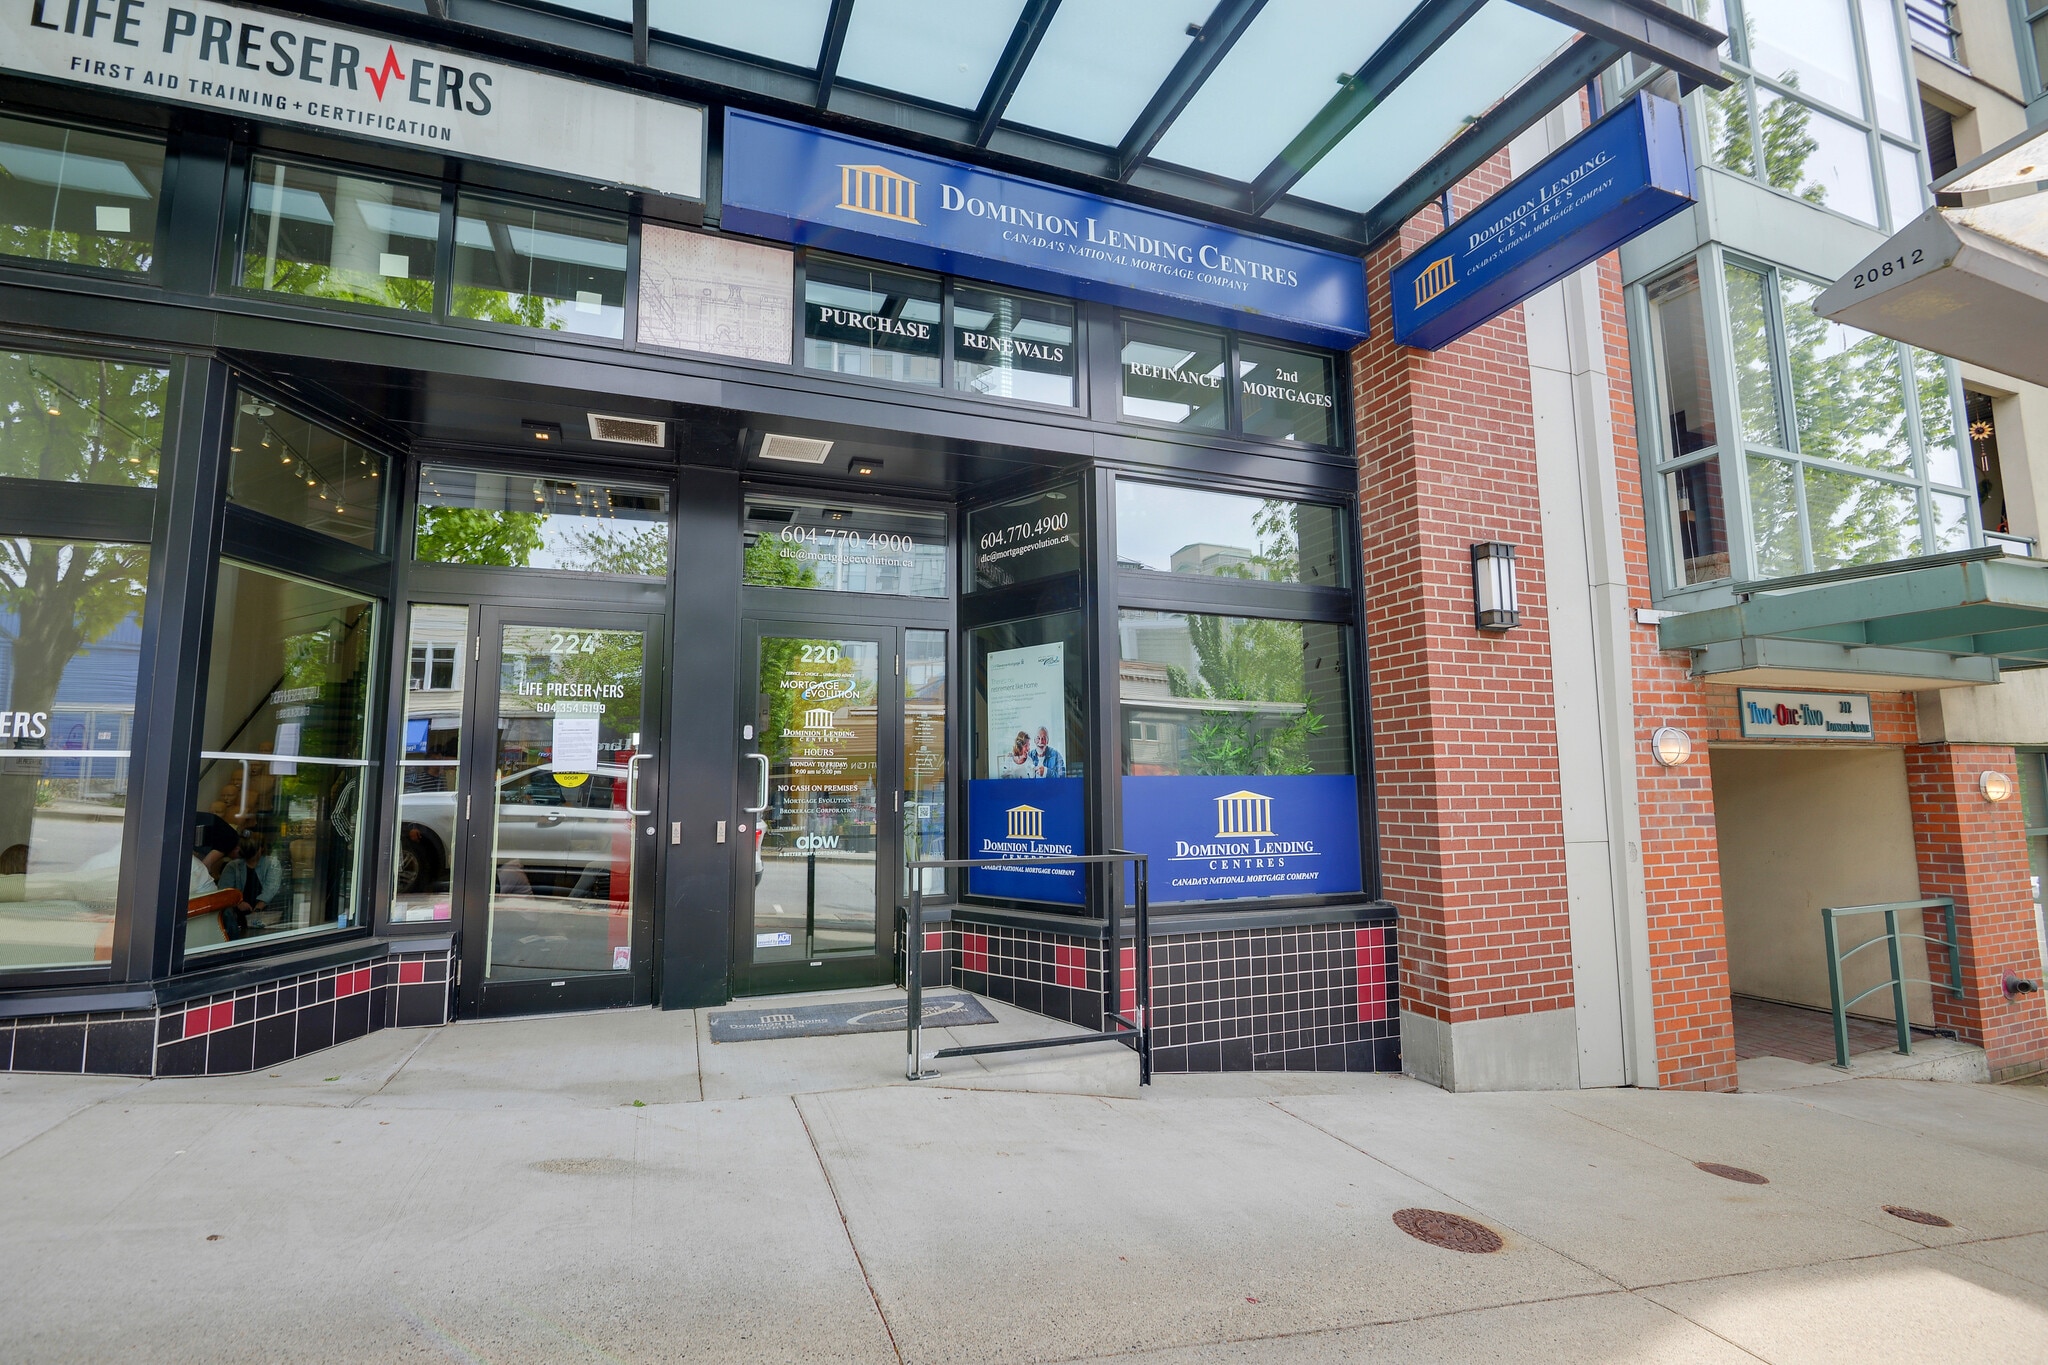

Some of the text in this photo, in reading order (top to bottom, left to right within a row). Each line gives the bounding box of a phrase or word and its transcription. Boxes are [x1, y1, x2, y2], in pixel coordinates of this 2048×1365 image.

[31, 0, 145, 47] LIFE
[70, 56, 135, 81] FIRST
[143, 70, 179, 90] AID
[188, 78, 287, 111] TRAINING
[307, 101, 452, 142] CERTIFICATION
[1498, 188, 1573, 244] CENTRES
[1498, 231, 1532, 257] NATIONAL
[1531, 204, 1574, 238] MORTGAGE
[1574, 177, 1615, 207] COMPANY
[939, 183, 1299, 288] DOMINION LENDING CENTRES
[1002, 230, 1250, 292] CANADA'S NATIONAL MORTGAGE COMPANY
[1853, 248, 1925, 290] 20812
[819, 306, 931, 340] PURCHASE
[963, 331, 1064, 362] RENEWALS
[1130, 361, 1221, 389] REFINANCE
[1275, 368, 1298, 383] 2nd
[1242, 380, 1332, 408] MORTGAGES
[780, 525, 913, 553] 604.770.4900
[980, 512, 1068, 550] 604.770.4900
[779, 548, 913, 568] dlc@mortgageevolution.ca
[980, 534, 1069, 563] dlc@mortgageevolution.ca
[550, 633, 596, 655] 224
[800, 644, 839, 664] 220
[518, 681, 543, 697] LIFE
[780, 680, 840, 690] MORTGAGE
[805, 689, 860, 699] EVOLUTION
[536, 702, 606, 714] 604.354.6199
[803, 748, 834, 757] HOURS
[824, 761, 847, 769] FRIDAY
[777, 784, 858, 792] NO CASH ON PREMISES
[796, 832, 840, 850] abw
[983, 838, 1072, 854] DOMINION LENDING
[1175, 838, 1314, 857] DOMINION LENDING
[1002, 865, 1025, 873] NATIONAL
[1024, 867, 1051, 875] MORTGAGE
[1051, 868, 1076, 876] COMPANY
[1209, 857, 1285, 870] CENTRES
[1171, 871, 1319, 887] CANADA'S NATIONAL MORTGAGE COMPANY
